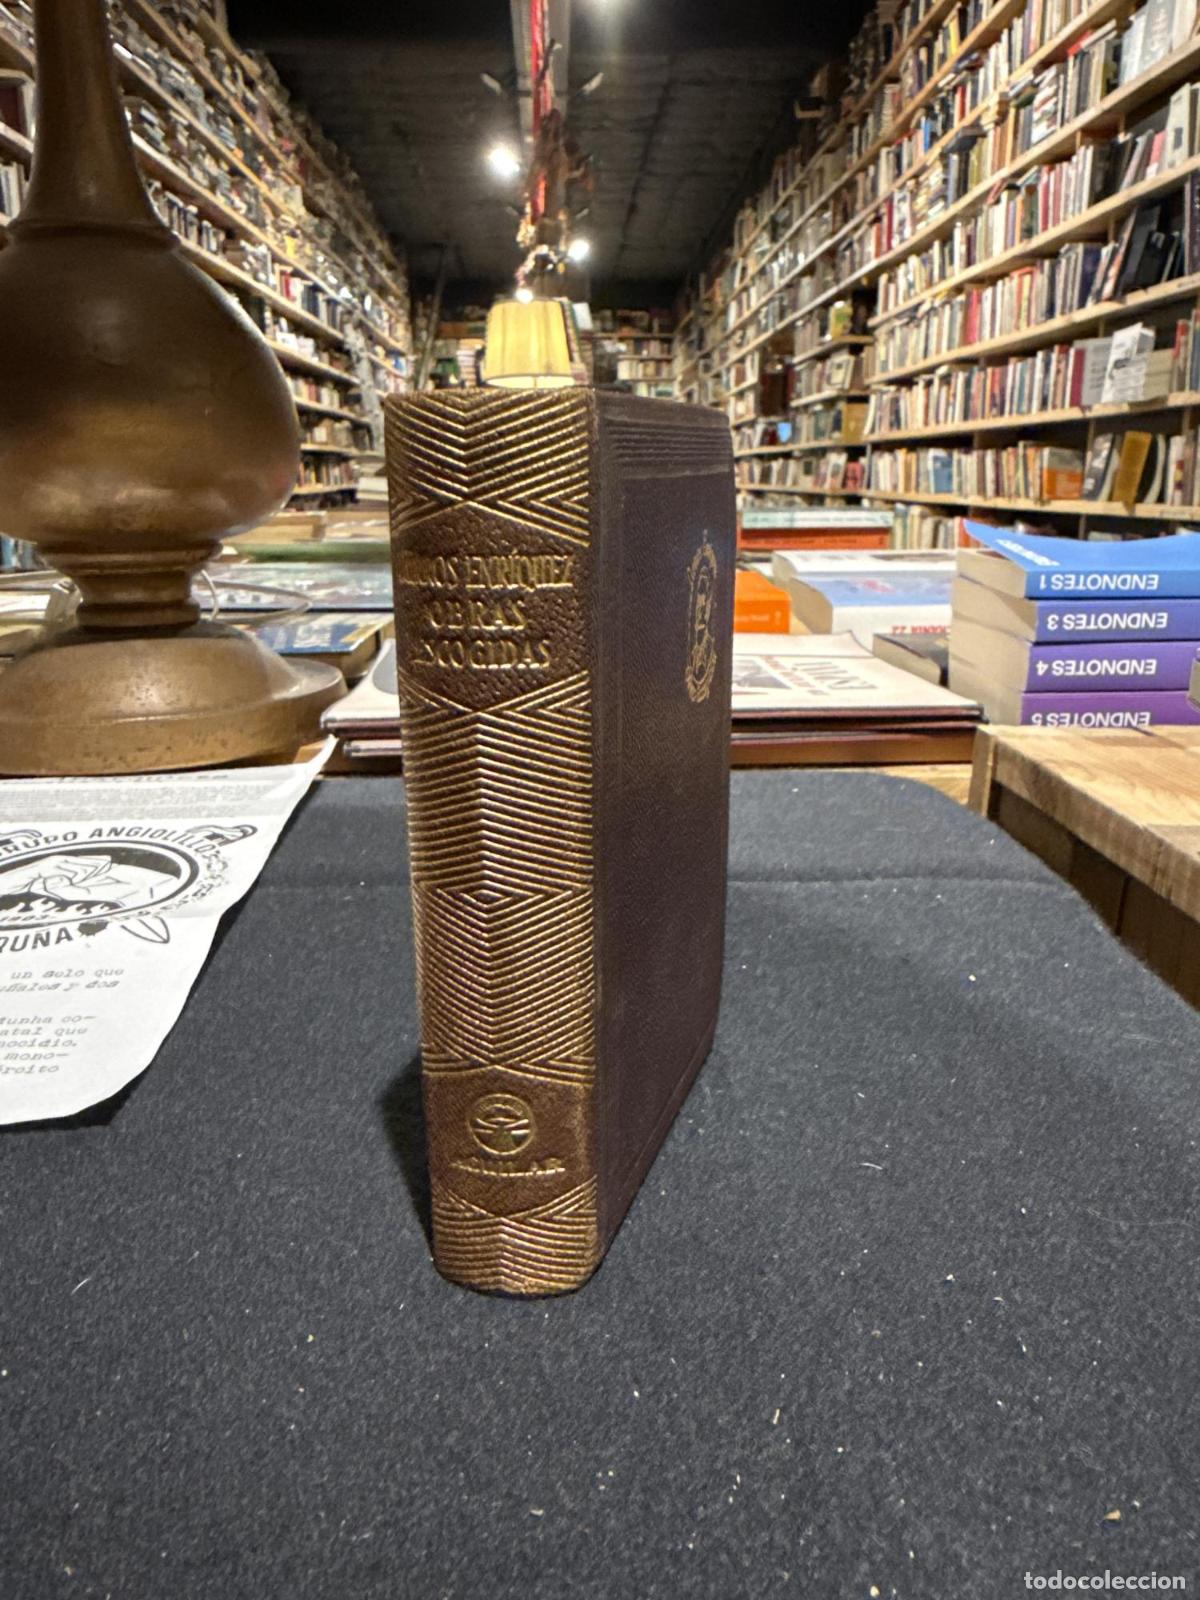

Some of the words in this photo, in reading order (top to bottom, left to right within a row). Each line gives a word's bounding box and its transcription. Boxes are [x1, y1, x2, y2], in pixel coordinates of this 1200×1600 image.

[1039, 574, 1047, 590] 1
[1050, 574, 1159, 590] ENDNOTES
[1046, 613, 1059, 630] 3
[1062, 612, 1168, 630] ENDNOTES
[1035, 659, 1049, 676] 4
[1051, 659, 1158, 676] ENDNOTES
[1046, 711, 1151, 727] ENDNOTES
[11, 970, 33, 980] un
